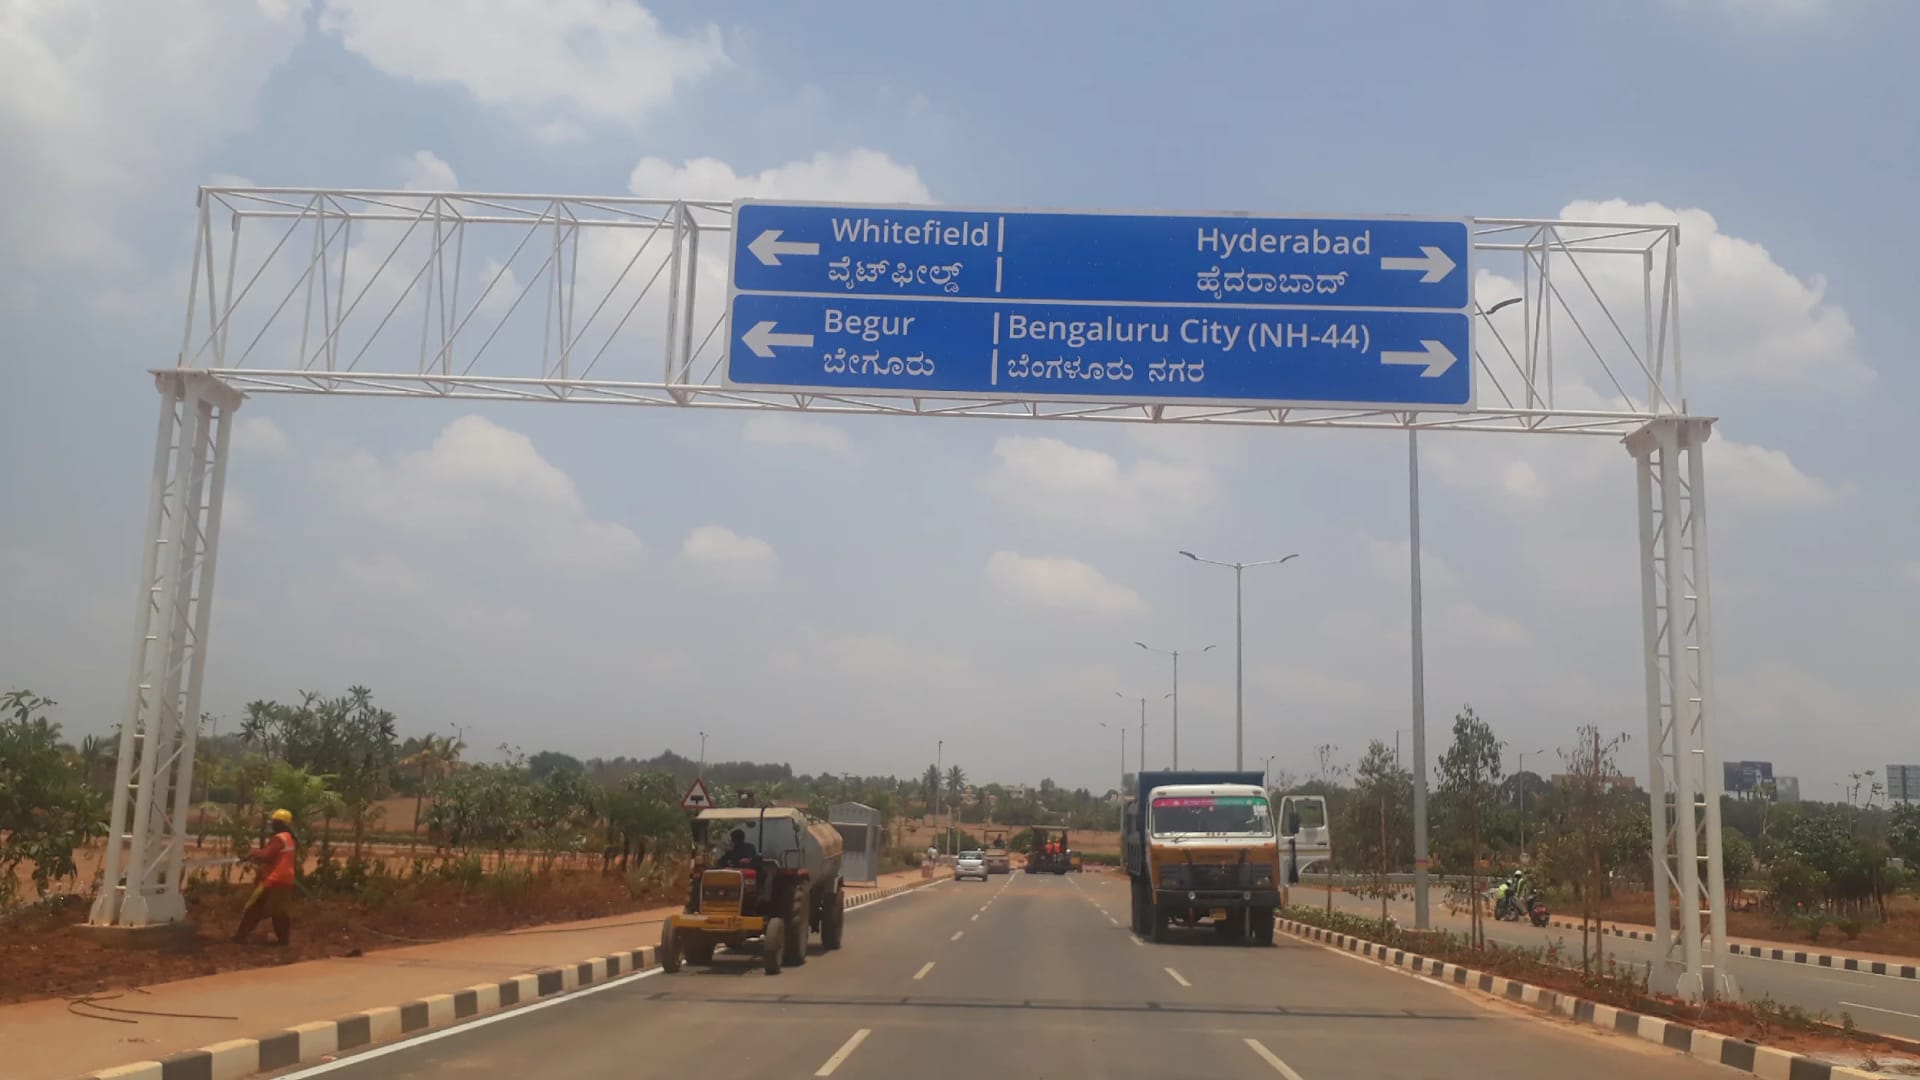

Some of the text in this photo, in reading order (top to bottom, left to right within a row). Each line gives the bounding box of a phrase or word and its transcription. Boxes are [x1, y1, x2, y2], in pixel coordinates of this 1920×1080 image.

[831, 217, 990, 247] Whitefield
[1197, 227, 1371, 258] Hyderabad
[1196, 265, 1349, 299] ಹೈದರಾಬಾದ್
[824, 308, 916, 342] Begur
[1009, 314, 1371, 354] Bengaluru City (NH-44)
[823, 347, 935, 377] ಬೇಗೂರು
[1007, 353, 1206, 383] ಬೆಂಗಳೂರು ನಗರ
